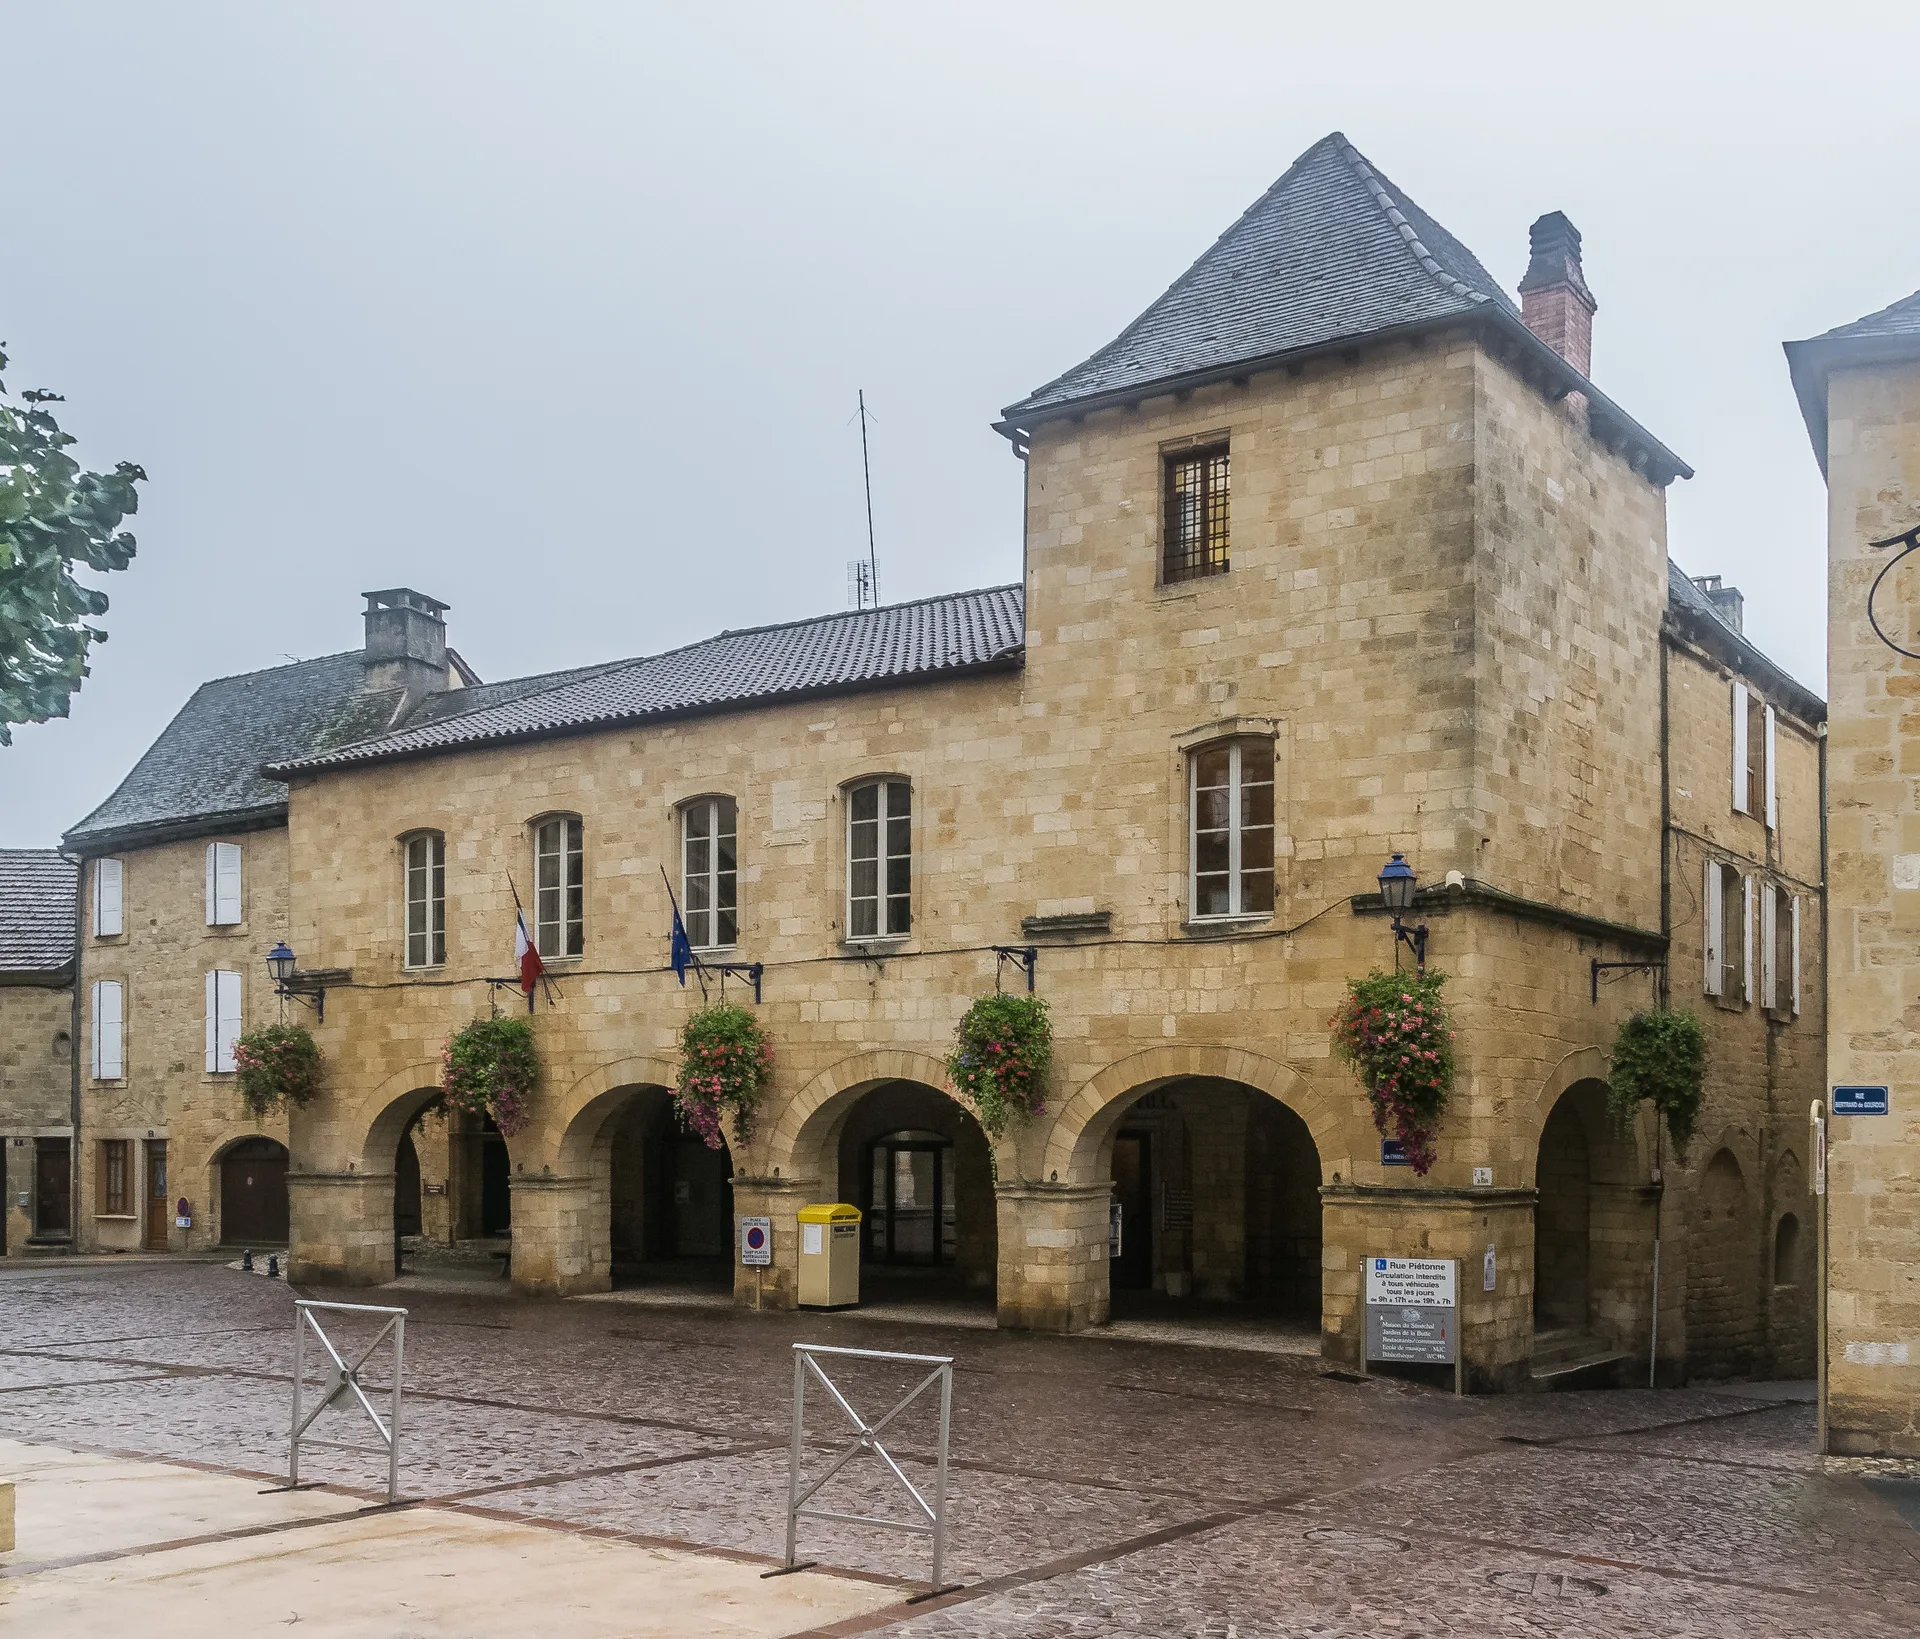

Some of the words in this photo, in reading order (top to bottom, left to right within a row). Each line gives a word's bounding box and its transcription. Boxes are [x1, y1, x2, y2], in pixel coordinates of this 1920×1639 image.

[1855, 1092, 1865, 1100] RUE
[1390, 1261, 1406, 1269] Rue
[1408, 1262, 1446, 1271] Piétonne
[1375, 1271, 1414, 1280] Circulation
[1415, 1289, 1435, 1297] jours
[1378, 1295, 1388, 1303] 9h
[1394, 1296, 1406, 1304] 17h
[1422, 1297, 1435, 1305] 19h
[1382, 1321, 1402, 1329] Maison
[1410, 1322, 1435, 1330] Sénéchal
[1404, 1346, 1427, 1354] musique
[1432, 1346, 1446, 1354] MJC
[1382, 1352, 1415, 1360] Bibliothèque
